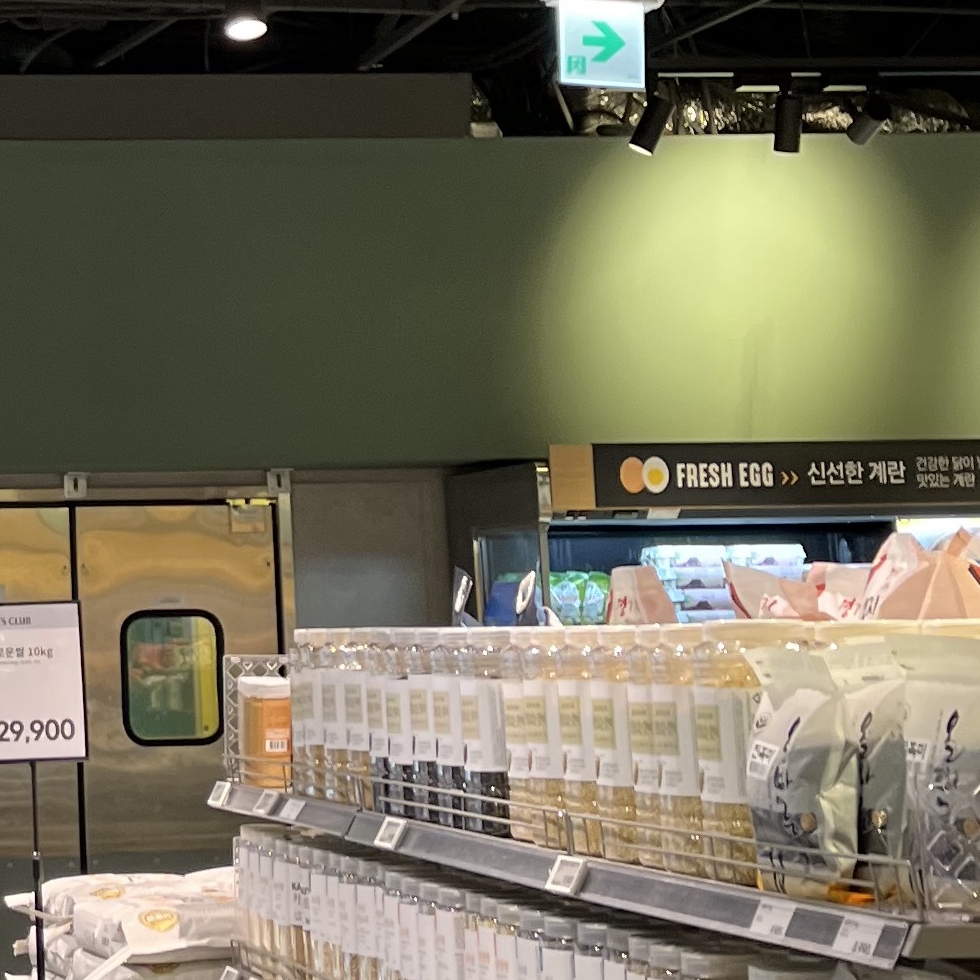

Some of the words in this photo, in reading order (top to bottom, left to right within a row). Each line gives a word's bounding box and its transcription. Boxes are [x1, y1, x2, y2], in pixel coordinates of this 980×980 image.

[676, 462, 733, 488] FRESH
[739, 462, 774, 488] EGG
[807, 461, 865, 486] 신선한
[869, 460, 906, 485] 계란
[28, 645, 53, 659] 10kg
